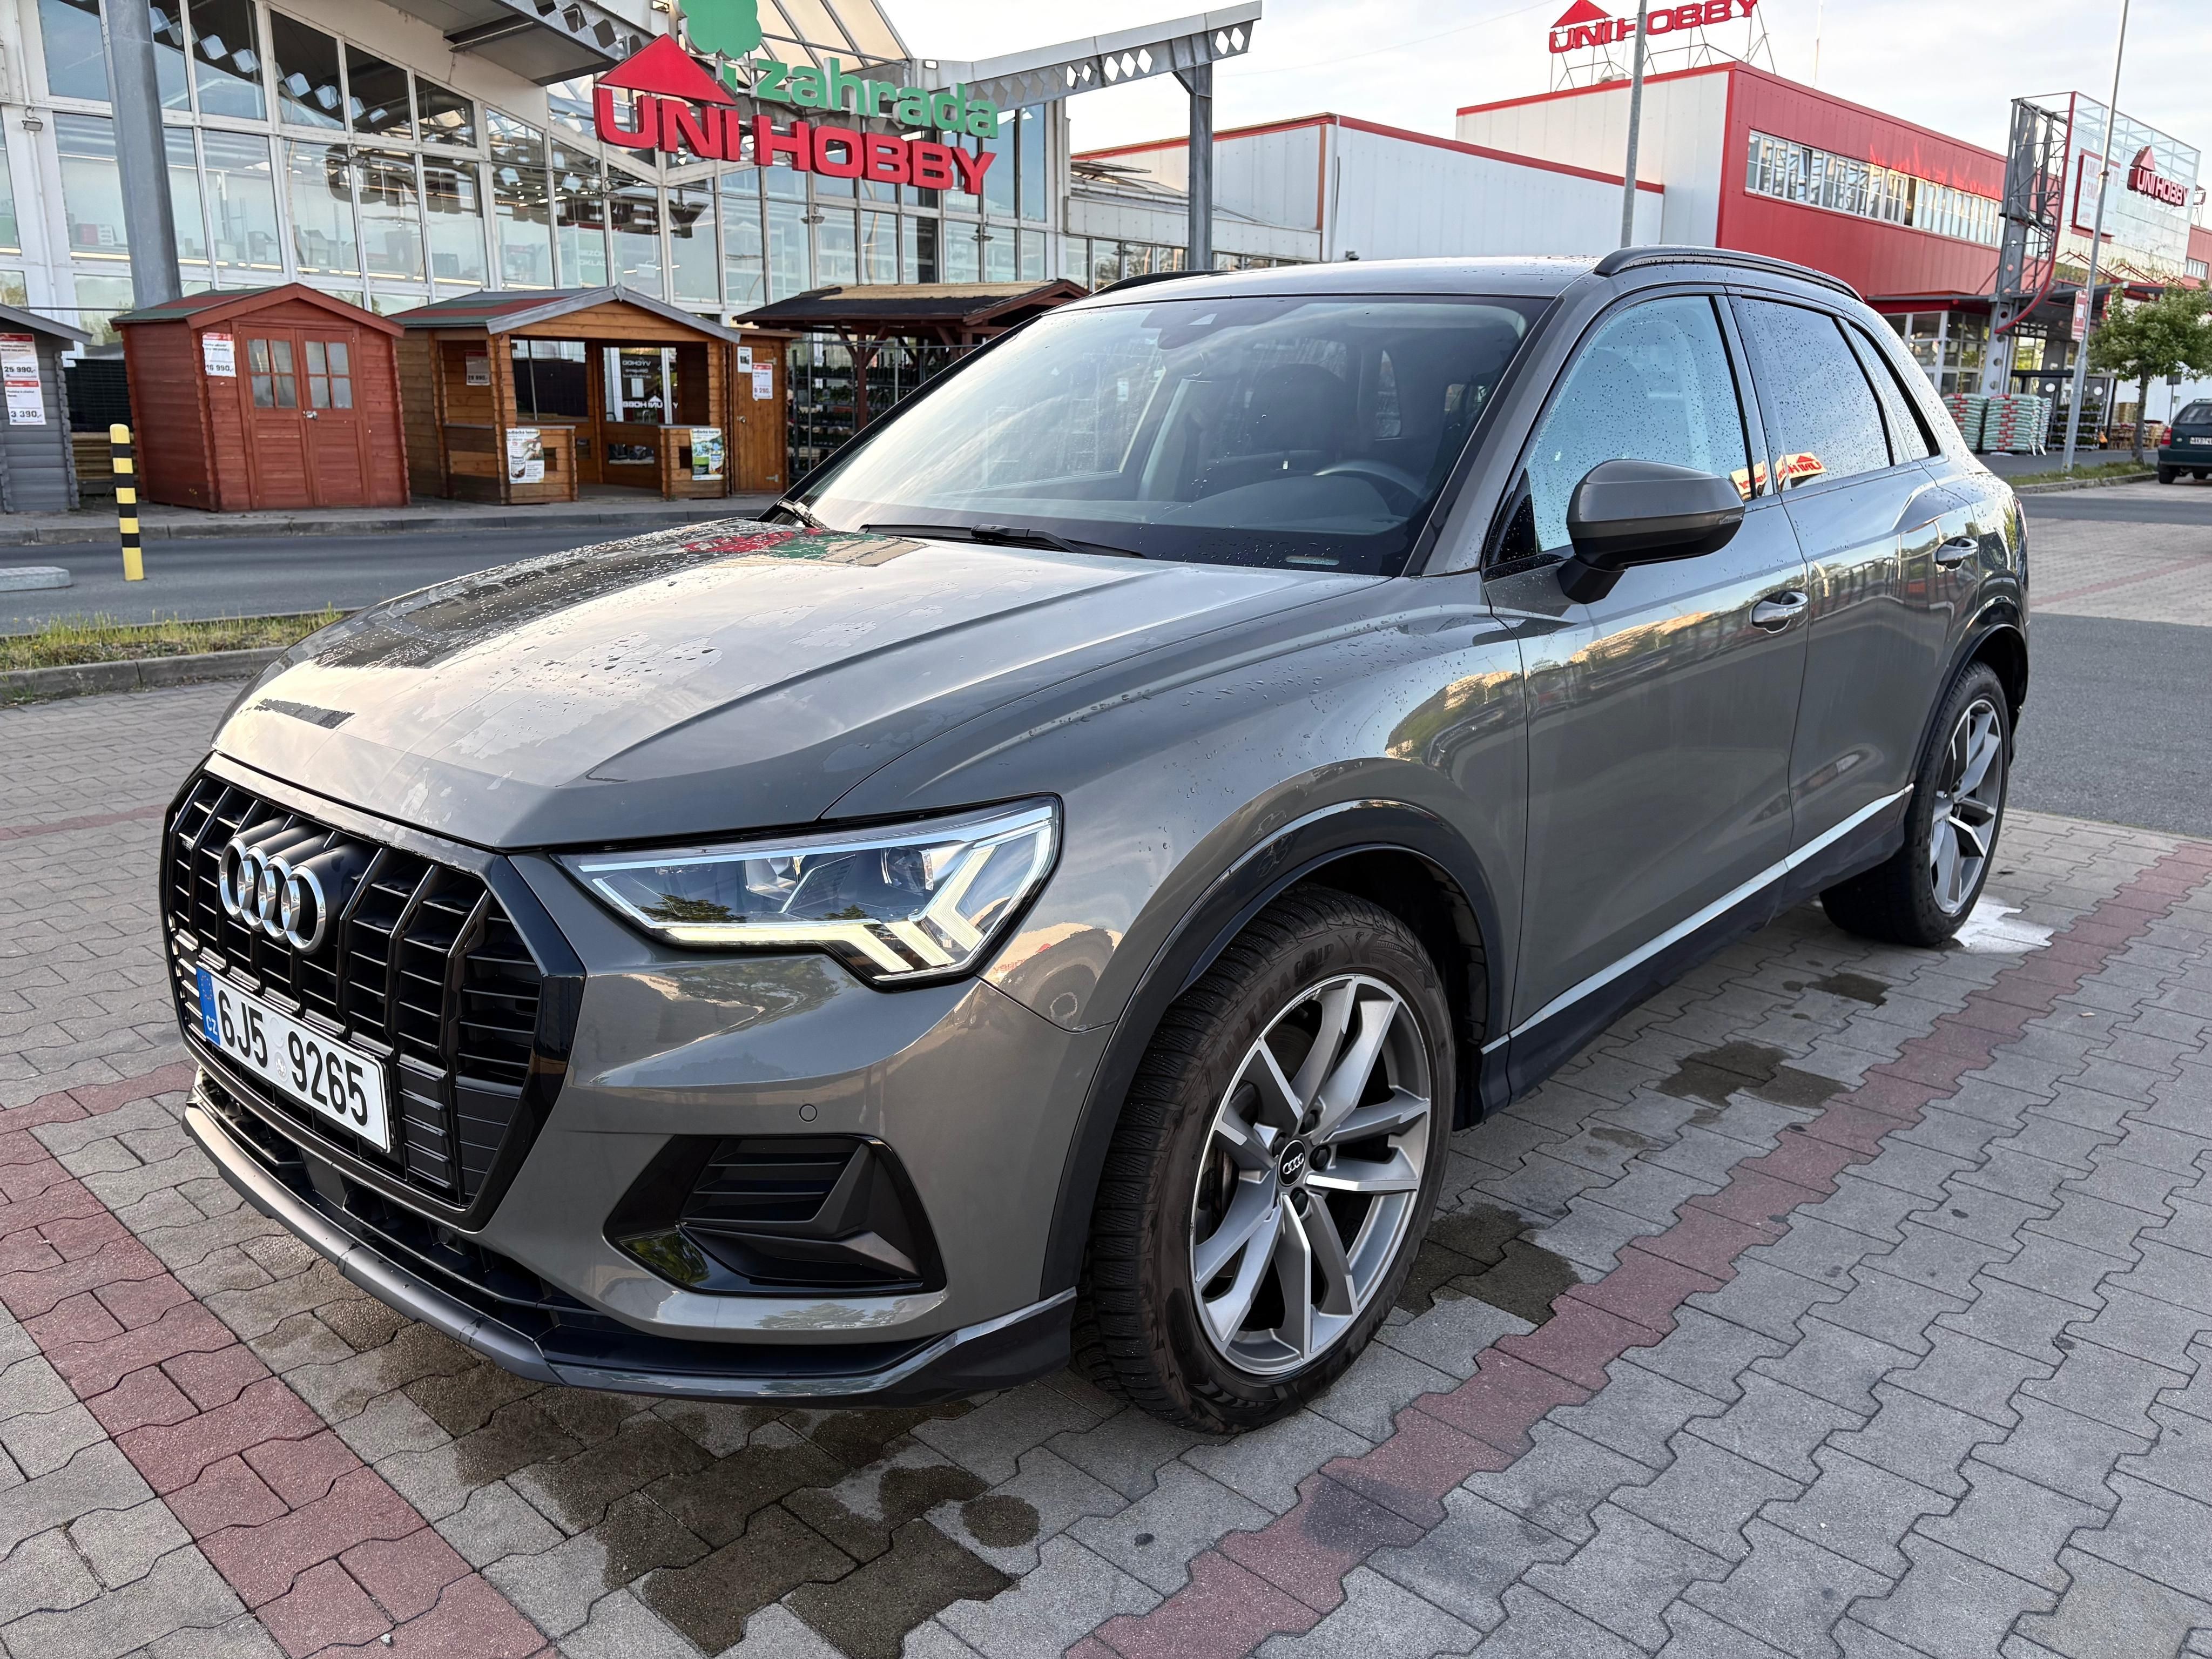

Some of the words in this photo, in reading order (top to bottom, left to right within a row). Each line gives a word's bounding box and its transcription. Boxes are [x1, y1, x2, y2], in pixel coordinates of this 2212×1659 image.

[1549, 20, 1613, 53] UNI
[1616, 0, 1758, 42] HOBBY
[754, 56, 999, 139] zahrada
[592, 86, 741, 162] UNI
[751, 113, 997, 195] HOBBY
[2136, 167, 2155, 195] UNI
[2155, 176, 2190, 207] HOBBY
[206, 1015, 218, 1036] CZ
[218, 989, 268, 1069] 6J5
[287, 1030, 368, 1127] 9265
